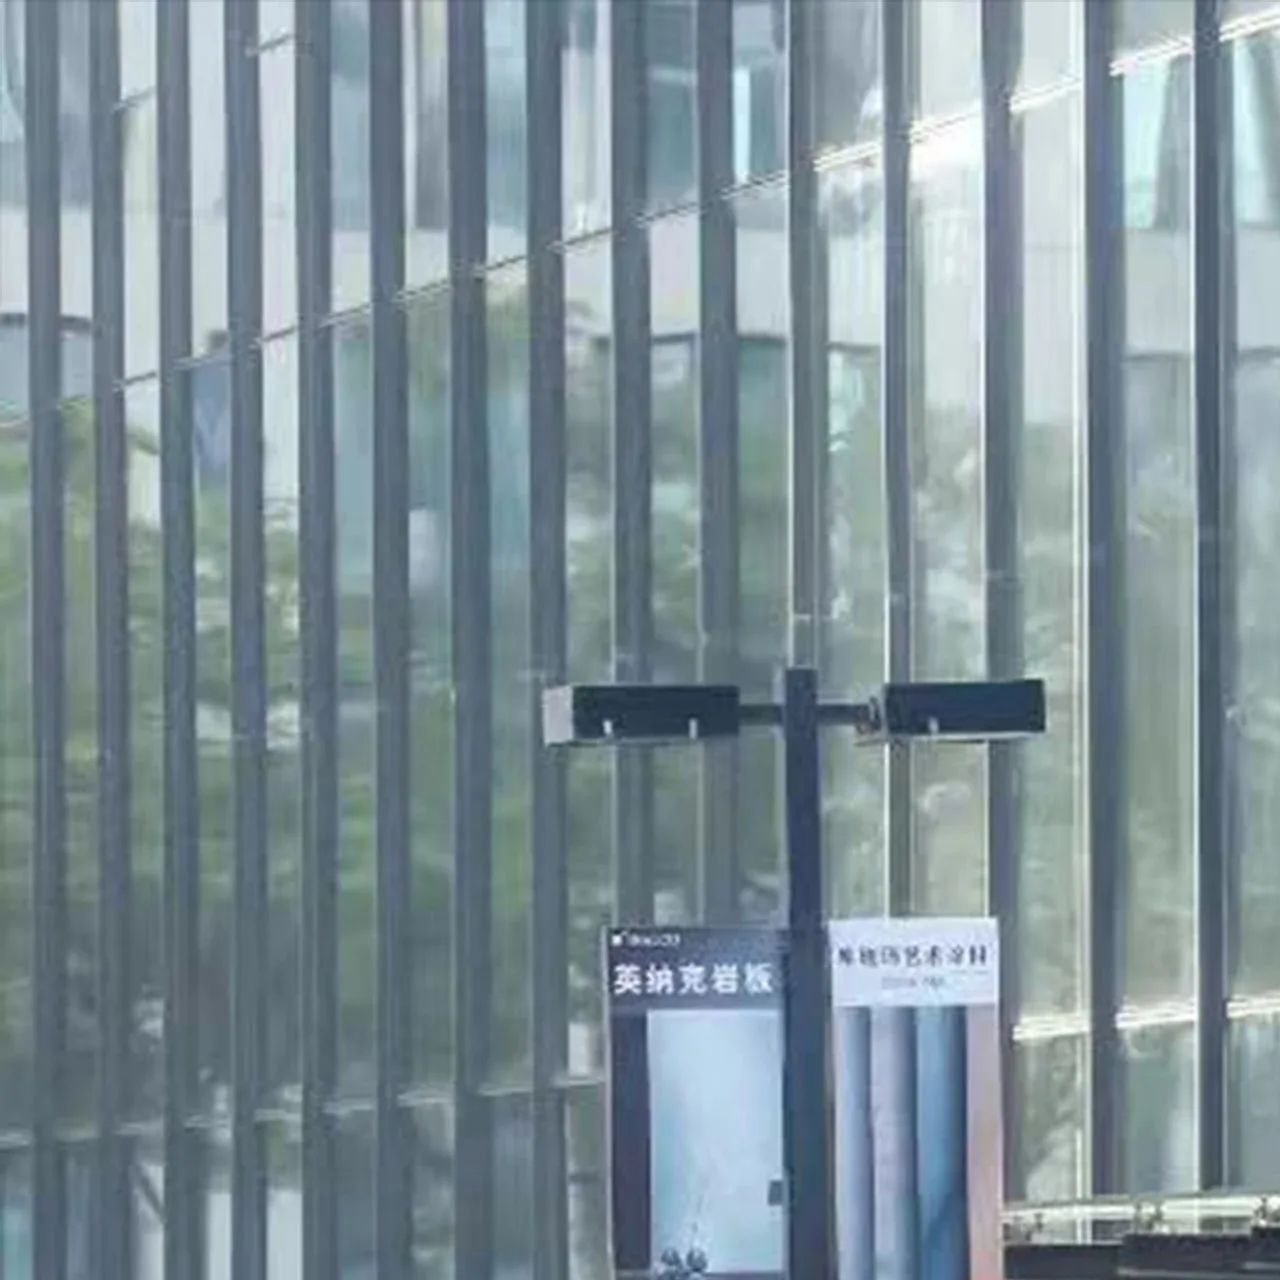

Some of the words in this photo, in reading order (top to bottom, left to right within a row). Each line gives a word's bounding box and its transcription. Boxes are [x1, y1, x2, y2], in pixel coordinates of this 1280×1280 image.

[613, 962, 774, 996] 英纳克岩板
